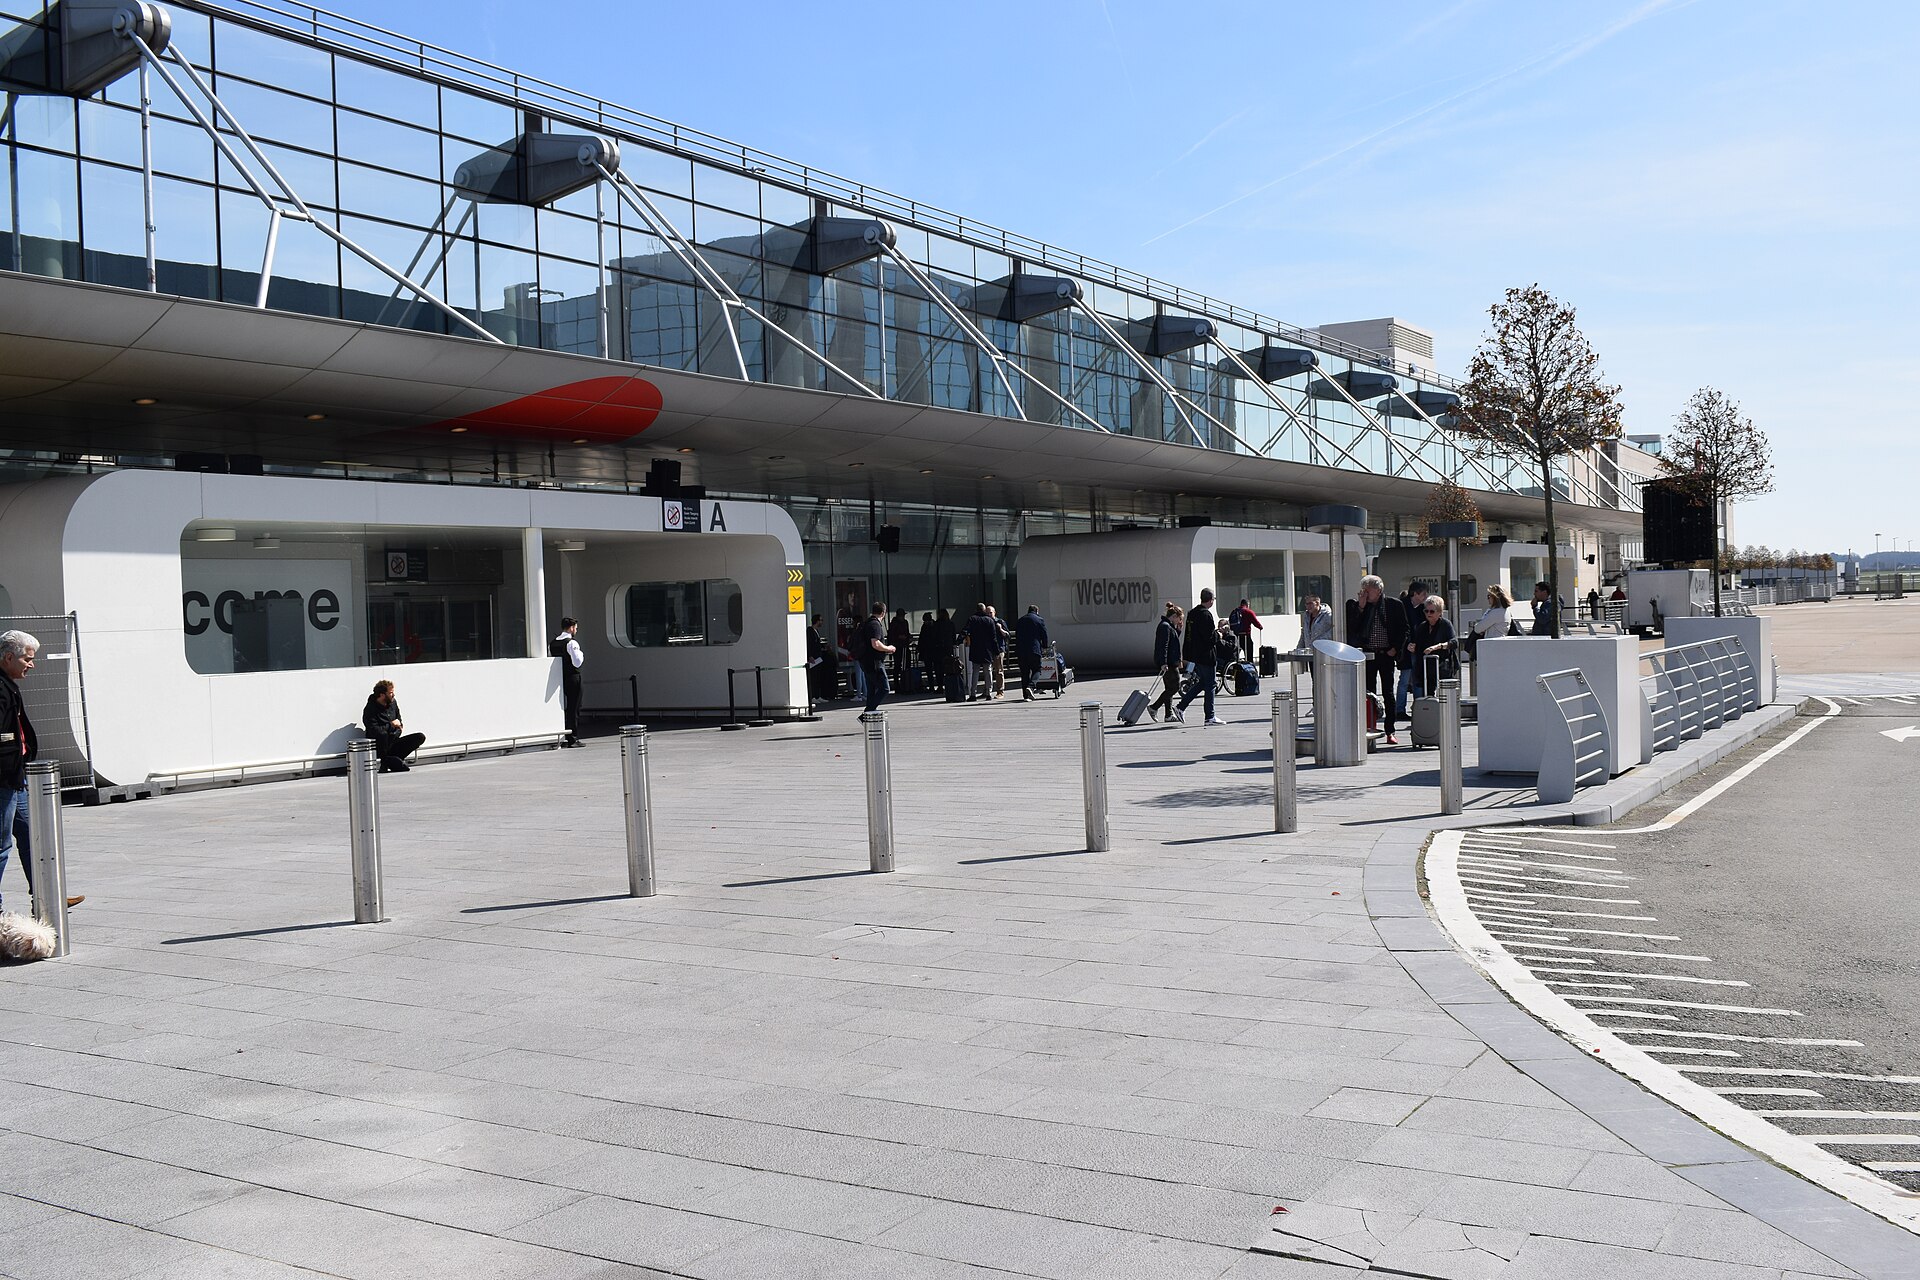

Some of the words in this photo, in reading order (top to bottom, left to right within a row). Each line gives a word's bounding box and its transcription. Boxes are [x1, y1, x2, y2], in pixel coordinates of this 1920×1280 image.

[709, 502, 727, 532] A
[1076, 578, 1152, 606] Welcome
[182, 589, 340, 636] coe
